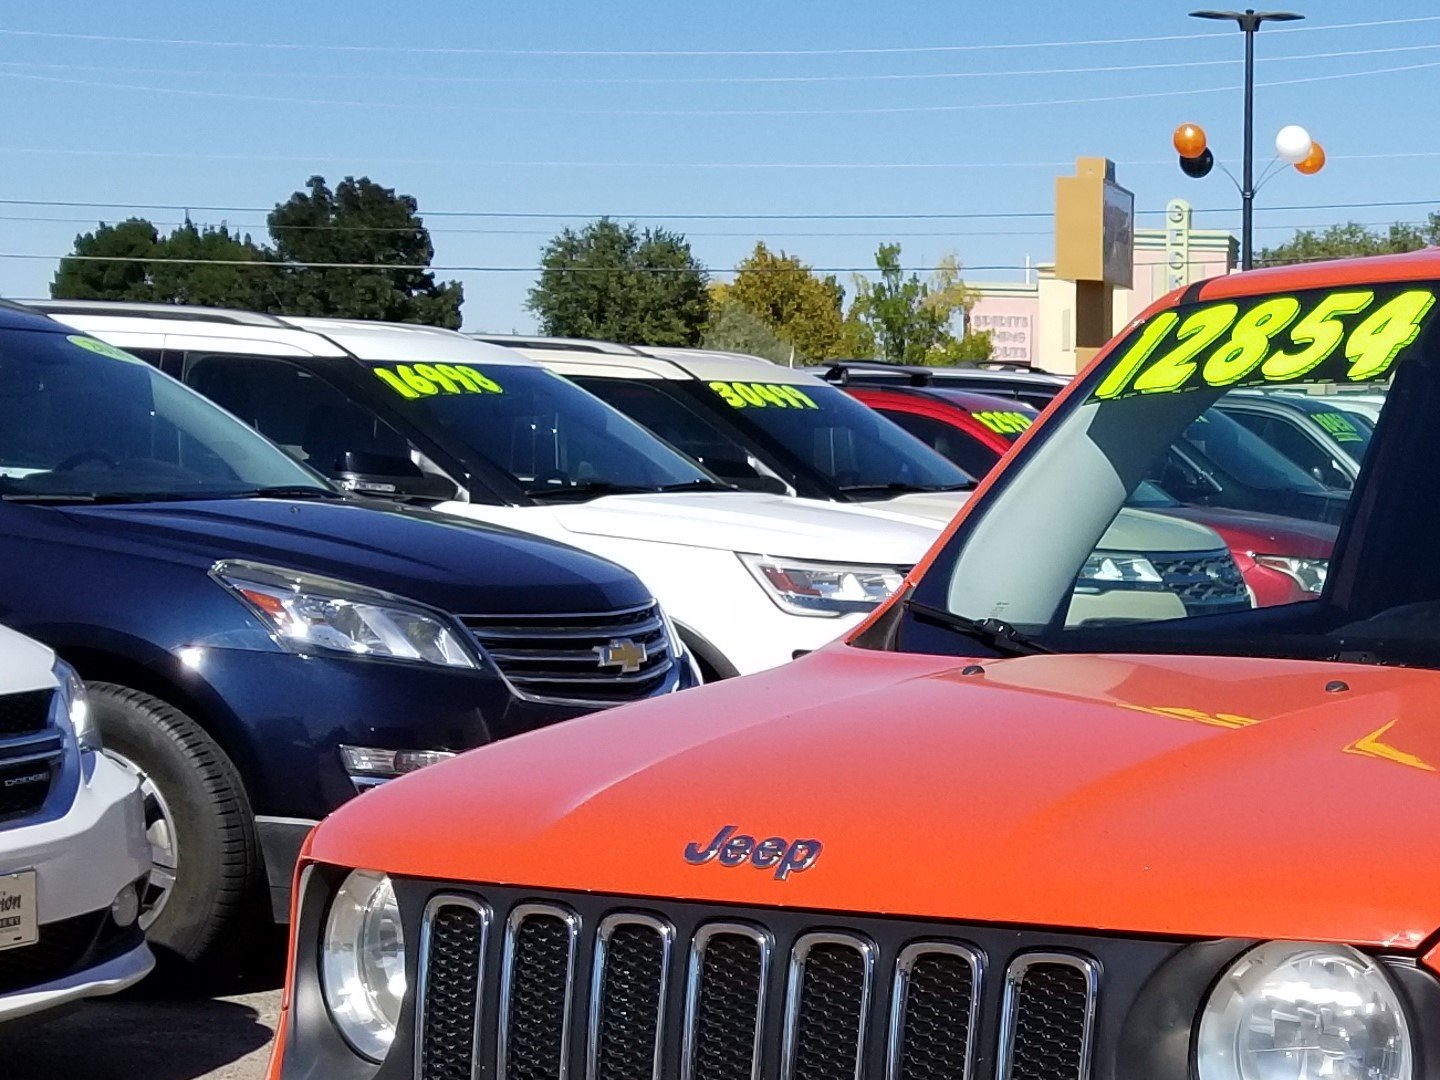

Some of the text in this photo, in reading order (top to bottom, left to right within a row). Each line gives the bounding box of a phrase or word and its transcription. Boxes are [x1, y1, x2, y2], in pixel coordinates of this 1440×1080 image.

[1095, 291, 1436, 399] 12854
[374, 363, 503, 398] 16998
[708, 381, 819, 410] 30499
[684, 825, 824, 881] Jeep
